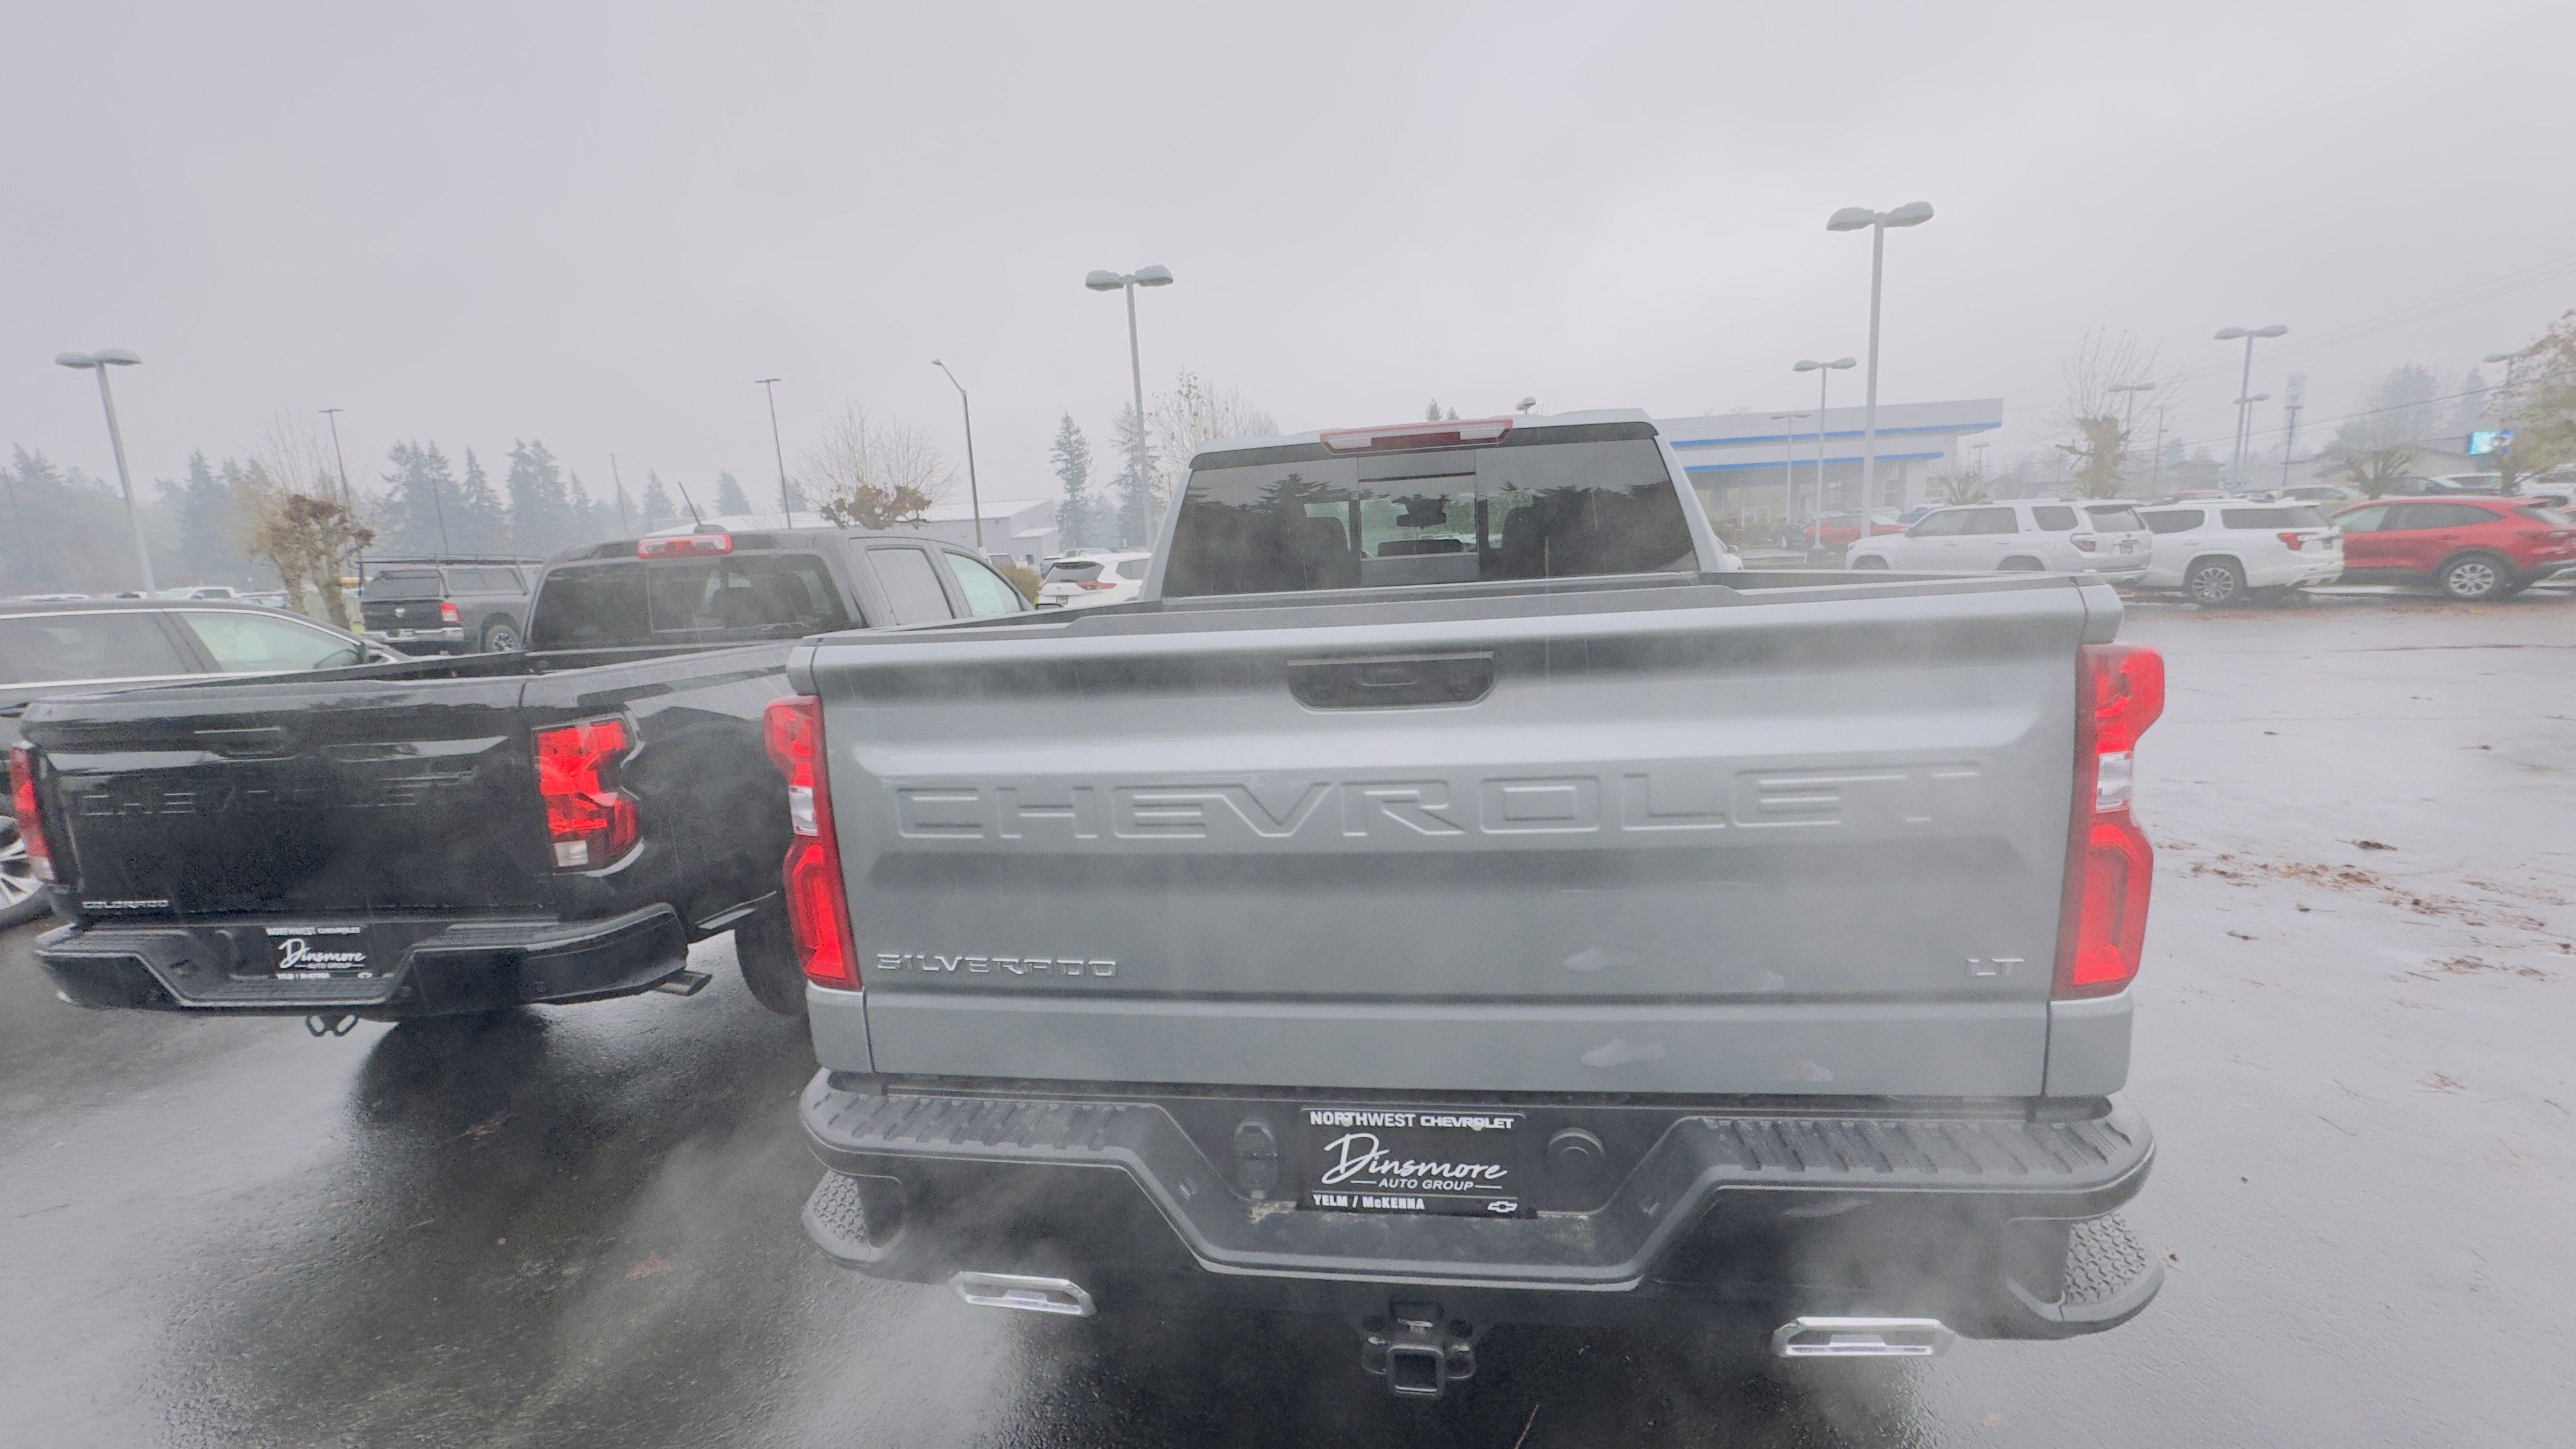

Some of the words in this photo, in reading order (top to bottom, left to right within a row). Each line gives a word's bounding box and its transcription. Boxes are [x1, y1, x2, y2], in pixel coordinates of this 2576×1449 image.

[897, 761, 1982, 839] CHEVROLET
[278, 938, 366, 969] Dinsmore
[877, 954, 1117, 976] SILVERADO
[1966, 958, 2025, 977] LT
[1310, 1111, 1416, 1128] NORTHWEST
[1420, 1115, 1515, 1130] CHEVROLET
[1321, 1132, 1508, 1185] Dinsmore
[1378, 1178, 1418, 1190] AUTO
[1422, 1179, 1475, 1192] GROUP
[1312, 1194, 1348, 1208] YELM
[1362, 1195, 1425, 1211] McKENNA
